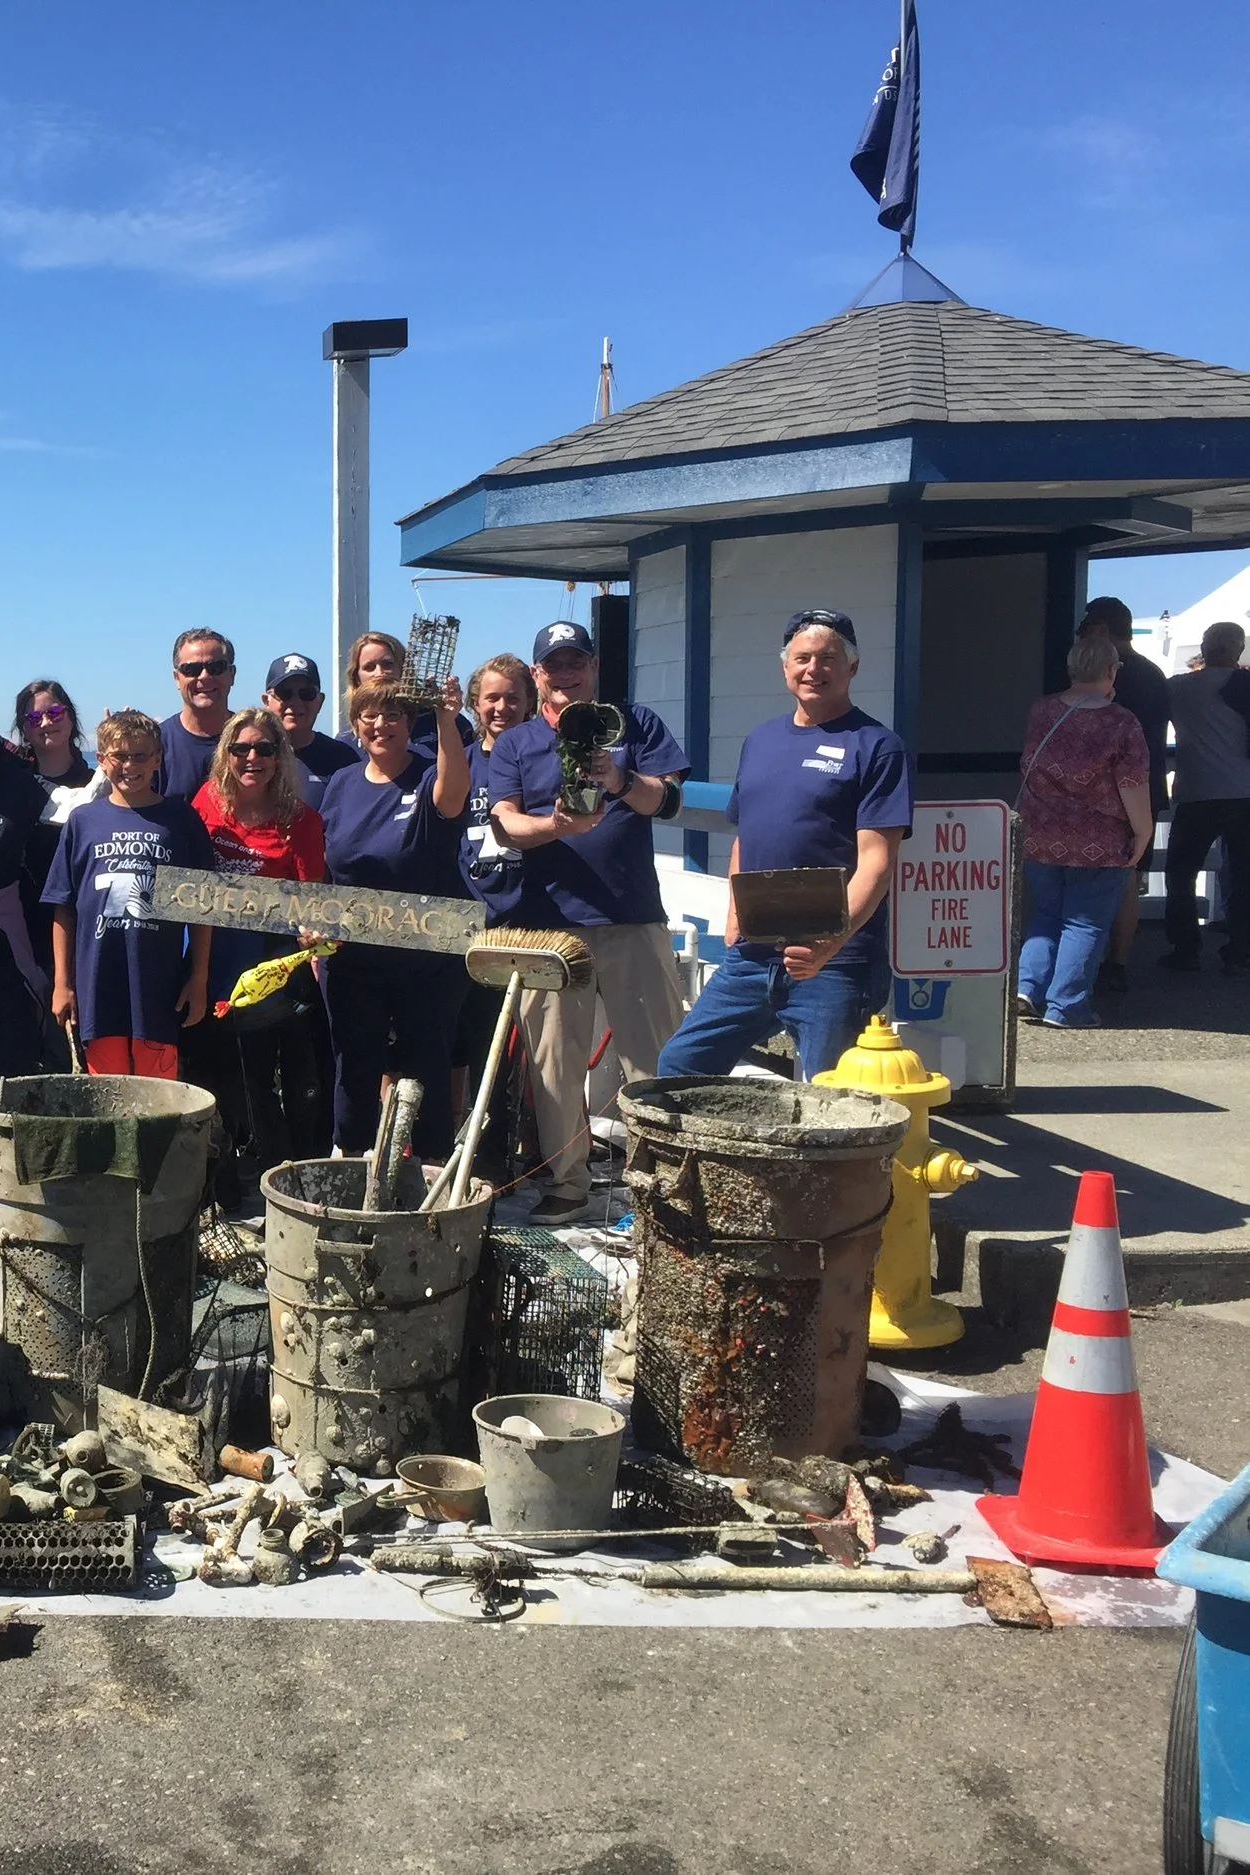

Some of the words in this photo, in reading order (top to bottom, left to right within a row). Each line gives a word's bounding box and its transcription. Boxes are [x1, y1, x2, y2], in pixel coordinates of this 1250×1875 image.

[111, 831, 142, 841] PORT
[144, 832, 160, 842] OF
[935, 823, 967, 853] NO
[94, 842, 172, 862] EDMONDS
[901, 859, 1001, 892] PARKING
[931, 898, 969, 921] FIRE
[94, 914, 130, 939] Years
[927, 926, 973, 949] LANE
